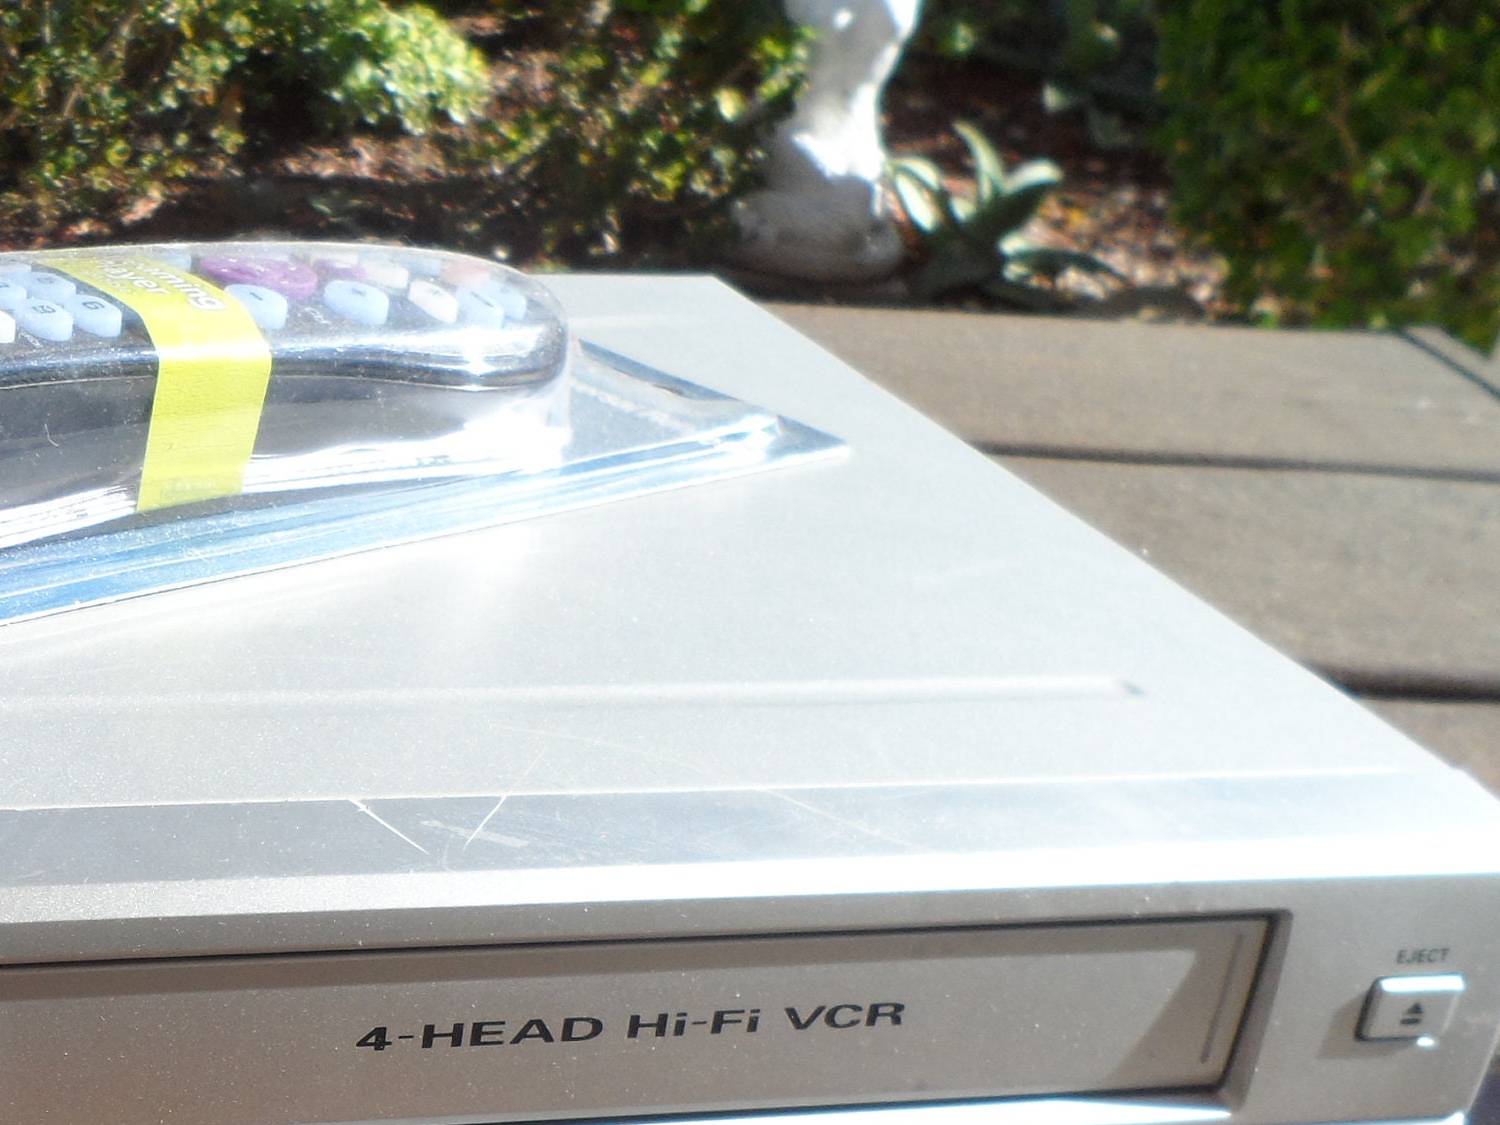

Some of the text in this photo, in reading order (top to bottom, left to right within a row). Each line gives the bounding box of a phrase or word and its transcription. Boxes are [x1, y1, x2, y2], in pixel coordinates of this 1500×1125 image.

[1396, 947, 1450, 965] EJECT
[355, 1001, 906, 1052] 4-HEAD Hi-Fi VCR
